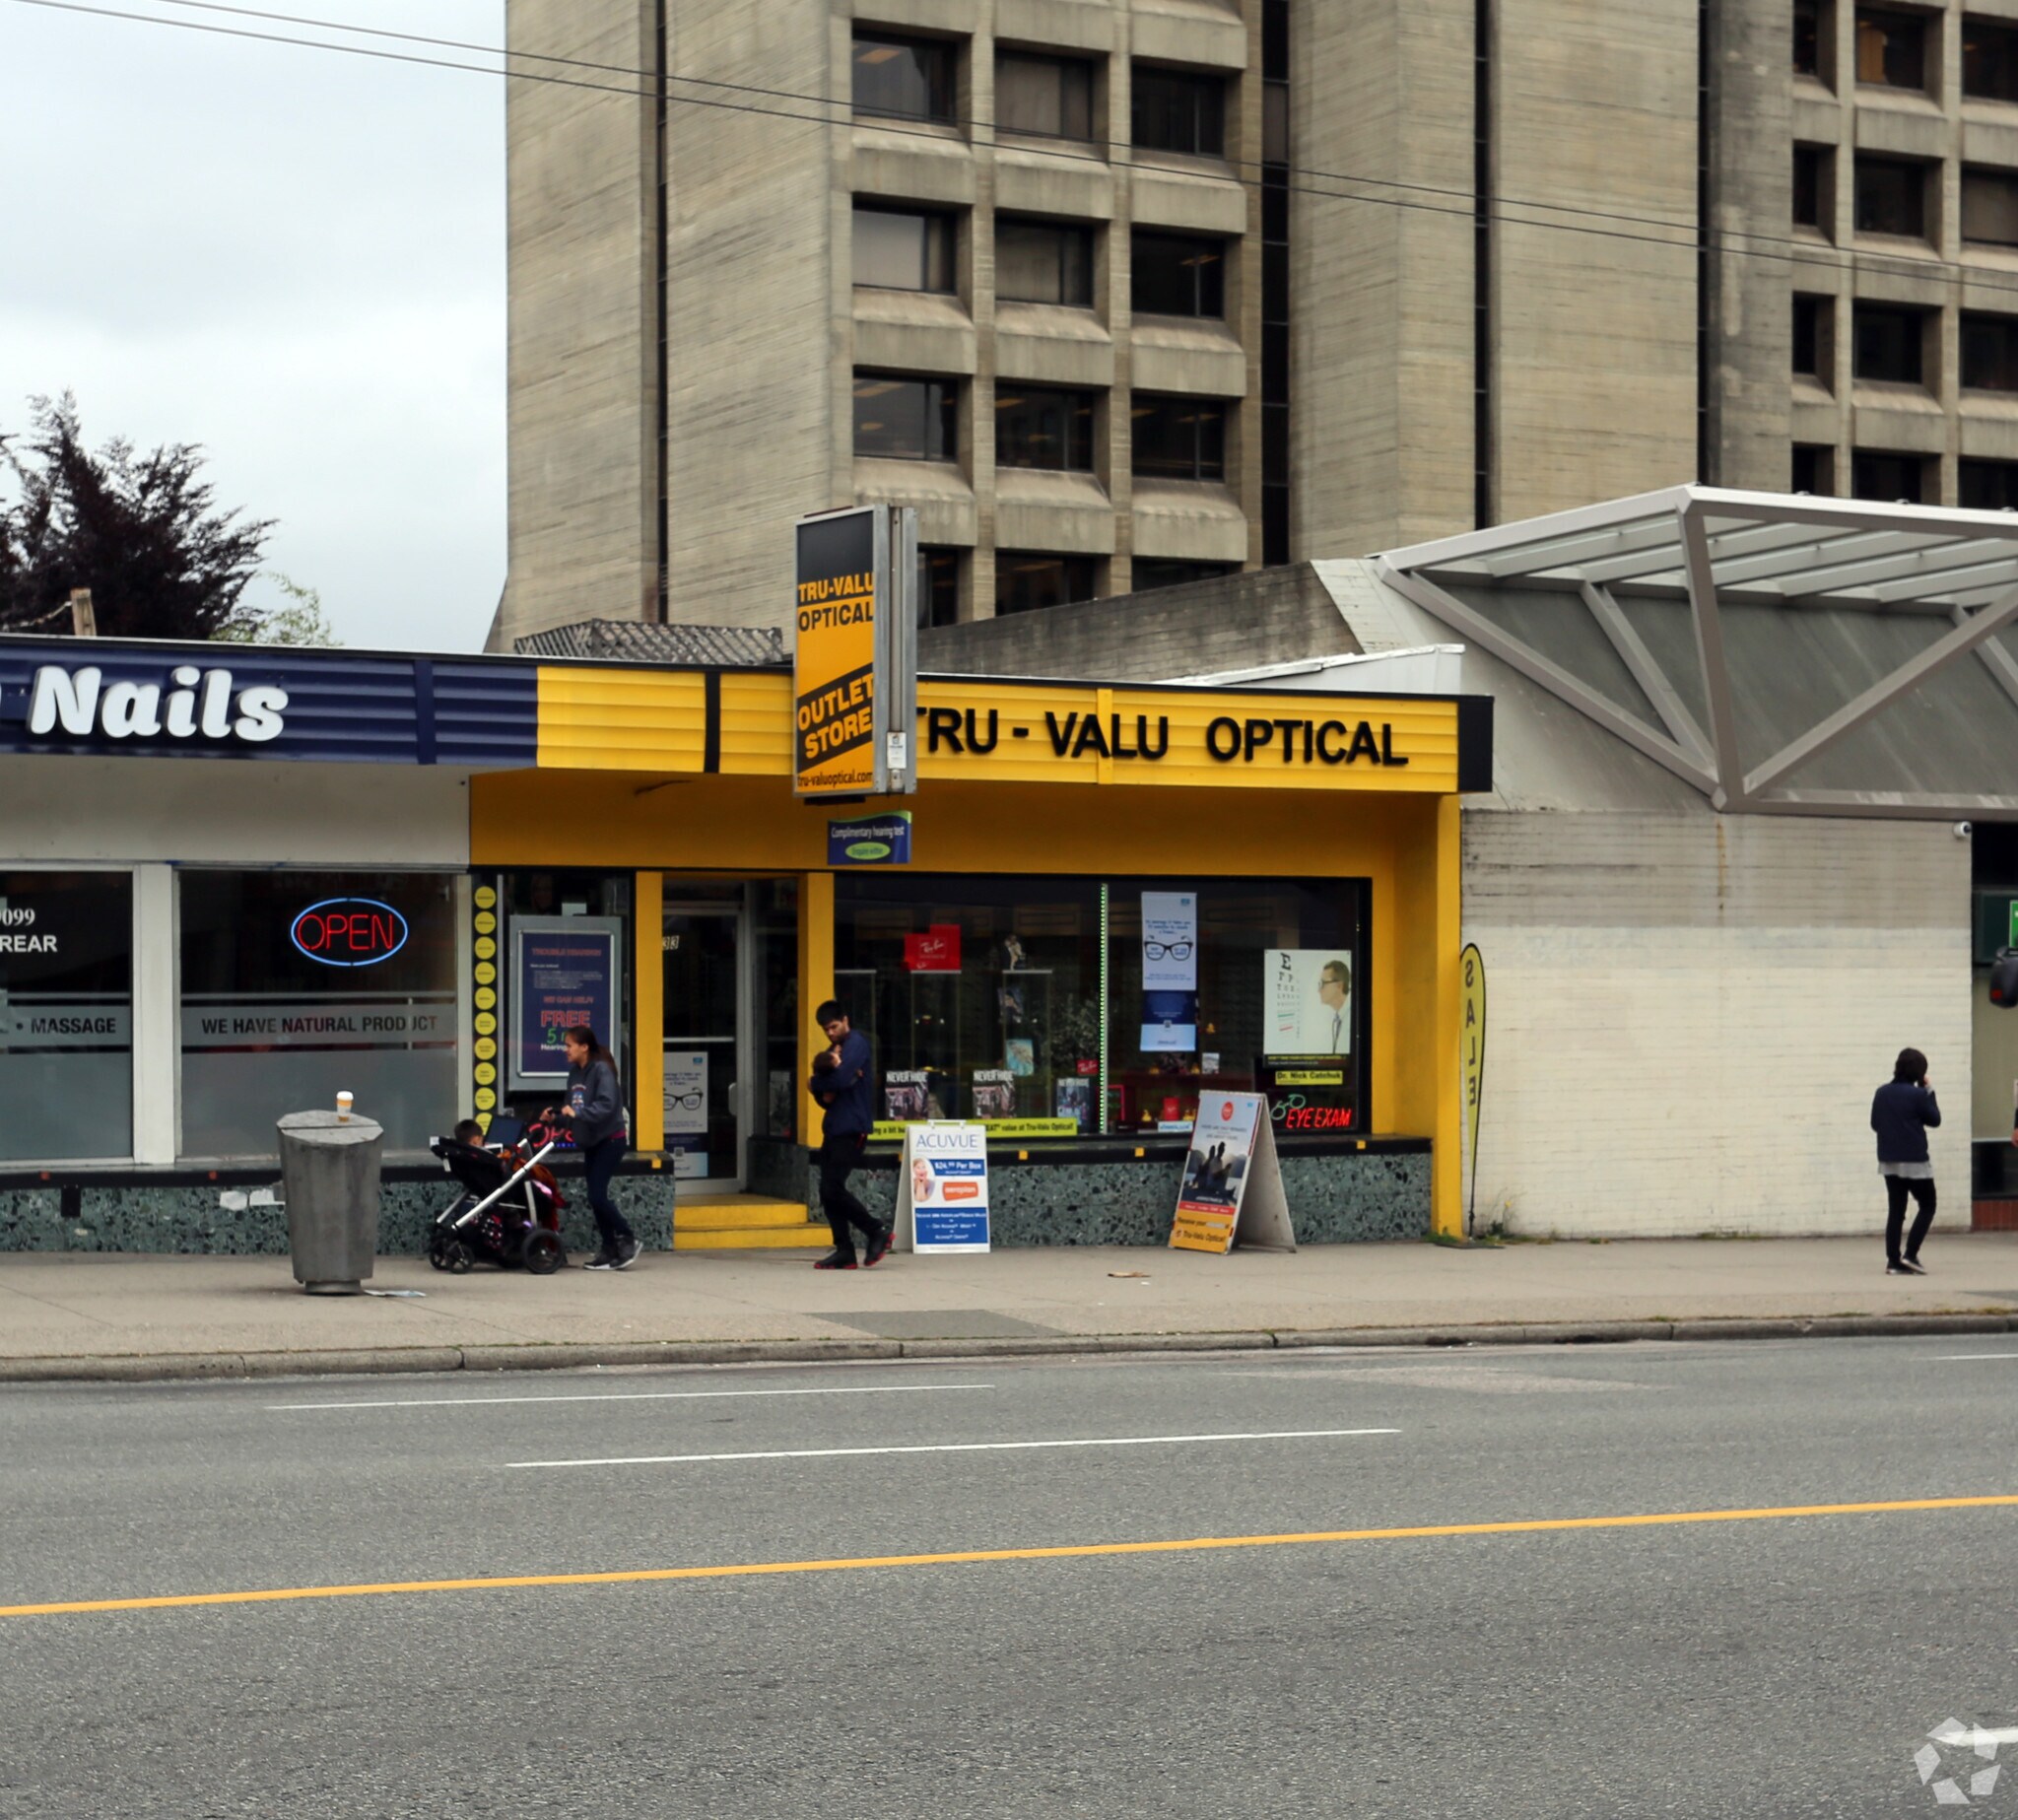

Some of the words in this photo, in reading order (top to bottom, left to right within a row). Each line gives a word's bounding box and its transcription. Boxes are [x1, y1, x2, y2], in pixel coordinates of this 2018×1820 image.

[798, 573, 873, 603] TRU-VALU
[798, 602, 873, 632] OPTICAL
[29, 664, 289, 741] Nails
[797, 672, 873, 731] OUTLET
[805, 707, 872, 759] STORE
[916, 707, 998, 754] RU
[1044, 711, 1169, 760] VALU
[1206, 716, 1409, 766] OPTICAL
[0, 909, 35, 926] 099
[0, 935, 57, 952] REAR
[298, 914, 393, 950] OPEN
[31, 1017, 116, 1035] MASSAGE
[201, 1018, 228, 1035] WE
[233, 1018, 277, 1034] HAVE
[282, 1017, 357, 1034] NATURAL
[541, 1010, 591, 1028] FREE
[547, 1028, 557, 1045] 5
[1286, 1108, 1313, 1128] EYE
[1313, 1107, 1352, 1128] EXAM
[916, 1134, 977, 1148] ACUVUE
